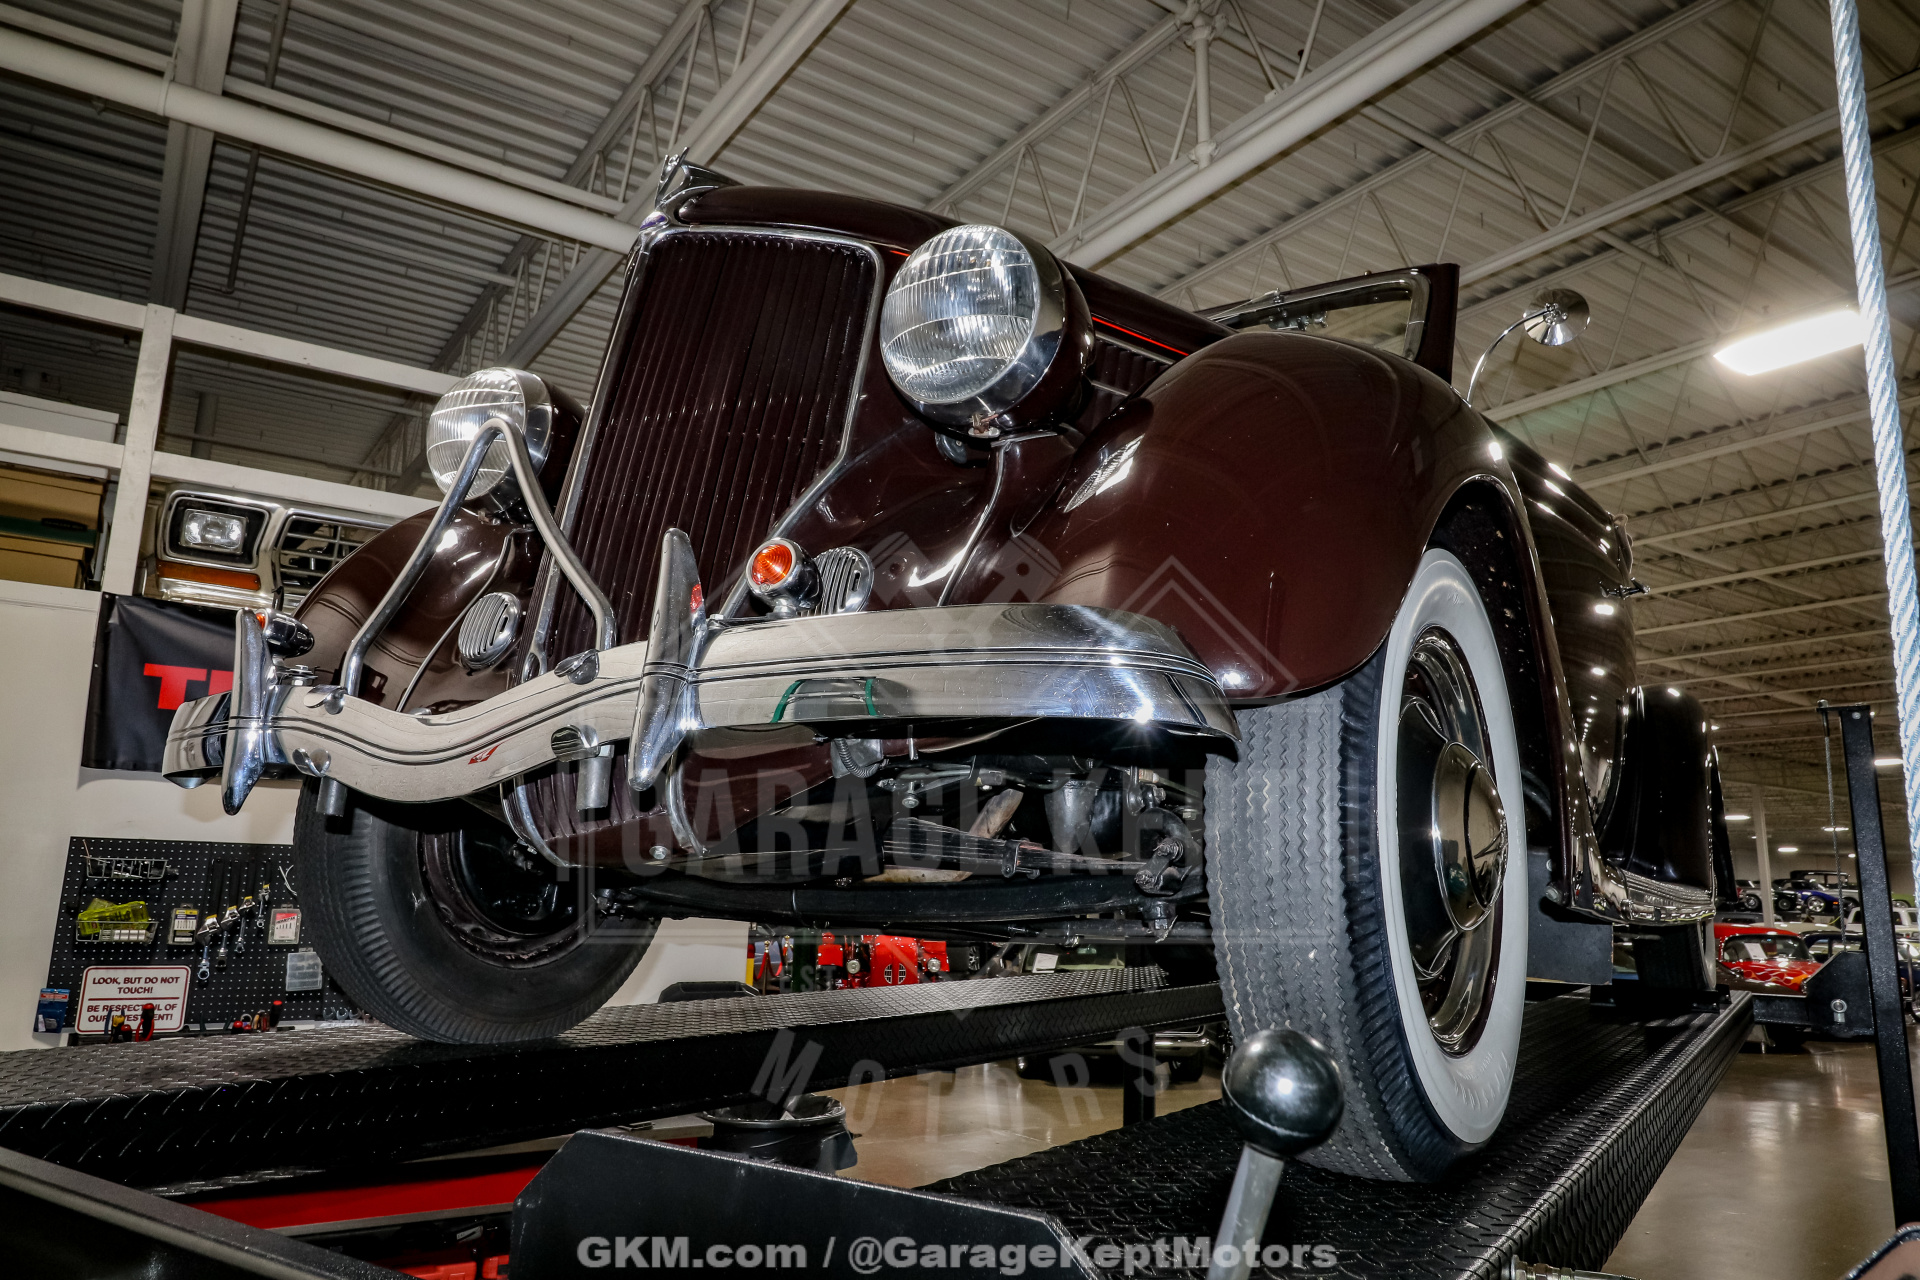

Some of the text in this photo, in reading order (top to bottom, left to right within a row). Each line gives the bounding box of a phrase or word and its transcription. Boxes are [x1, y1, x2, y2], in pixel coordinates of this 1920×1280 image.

[92, 976, 181, 985] LOOK, BUT DO NOT
[117, 986, 154, 995] TOUCH!
[164, 1003, 178, 1011] OF
